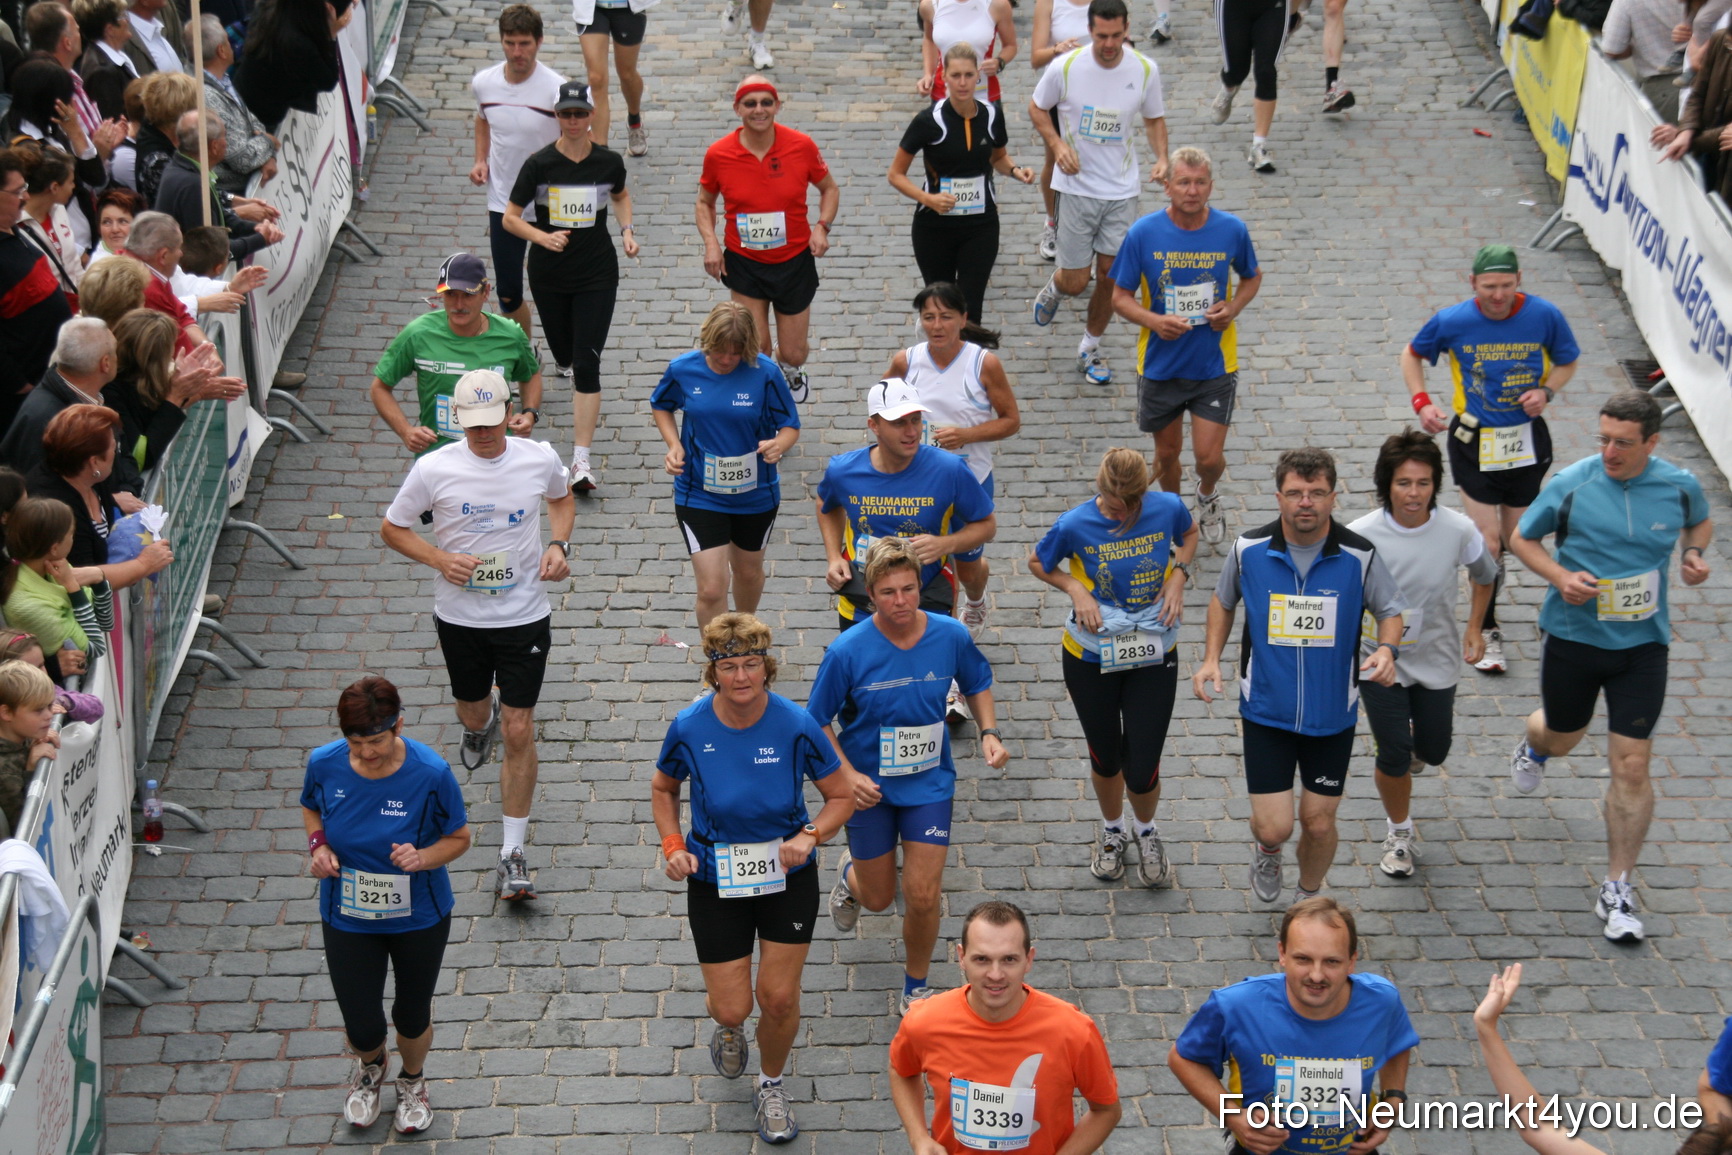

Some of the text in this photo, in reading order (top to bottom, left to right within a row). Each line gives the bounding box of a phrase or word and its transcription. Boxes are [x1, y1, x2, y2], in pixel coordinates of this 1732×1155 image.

[1094, 121, 1121, 133] 3025
[955, 190, 980, 202] 3024
[562, 203, 593, 215] 1044
[750, 217, 762, 225] Karl
[751, 227, 780, 238] 2747
[1153, 251, 1227, 261] 10. NEUMARKTER
[1164, 260, 1216, 269] STADTLAUF
[1177, 290, 1198, 298] Martin
[1179, 299, 1209, 311] 3656
[1462, 343, 1540, 353] 10. NEUMARKTER
[1475, 352, 1529, 361] STADTLAUF
[474, 387, 493, 402] Yip
[1495, 430, 1518, 439] Harald
[1502, 440, 1524, 455] 142
[719, 460, 742, 468] Bettina
[720, 468, 751, 481] 3283
[849, 495, 934, 507] 10. NEUMARKTER
[860, 506, 920, 516] STADTLAUF
[1084, 532, 1165, 555] 10. NEUMARKTER
[1098, 544, 1154, 562] STADTLAUF
[476, 567, 513, 581] 2465
[1615, 580, 1640, 591] Alfred
[1622, 591, 1651, 607] 220
[1288, 600, 1323, 611] Manfred
[1293, 616, 1325, 630] 420
[1116, 635, 1137, 644] Petra
[1119, 644, 1156, 660] 2839
[898, 731, 920, 740] Petra
[899, 741, 936, 758] 3370
[754, 756, 780, 764] Laaber
[387, 800, 403, 808] TSG
[381, 808, 407, 817] Laaber
[734, 846, 748, 856] Eva
[736, 859, 775, 877] 3281
[359, 876, 394, 888] Barbara
[360, 890, 402, 905] 3213
[1300, 1066, 1343, 1080] Reinhold
[973, 1089, 1004, 1104] Daniel
[1300, 1086, 1351, 1103] 3325
[973, 1108, 1023, 1128] 3339
